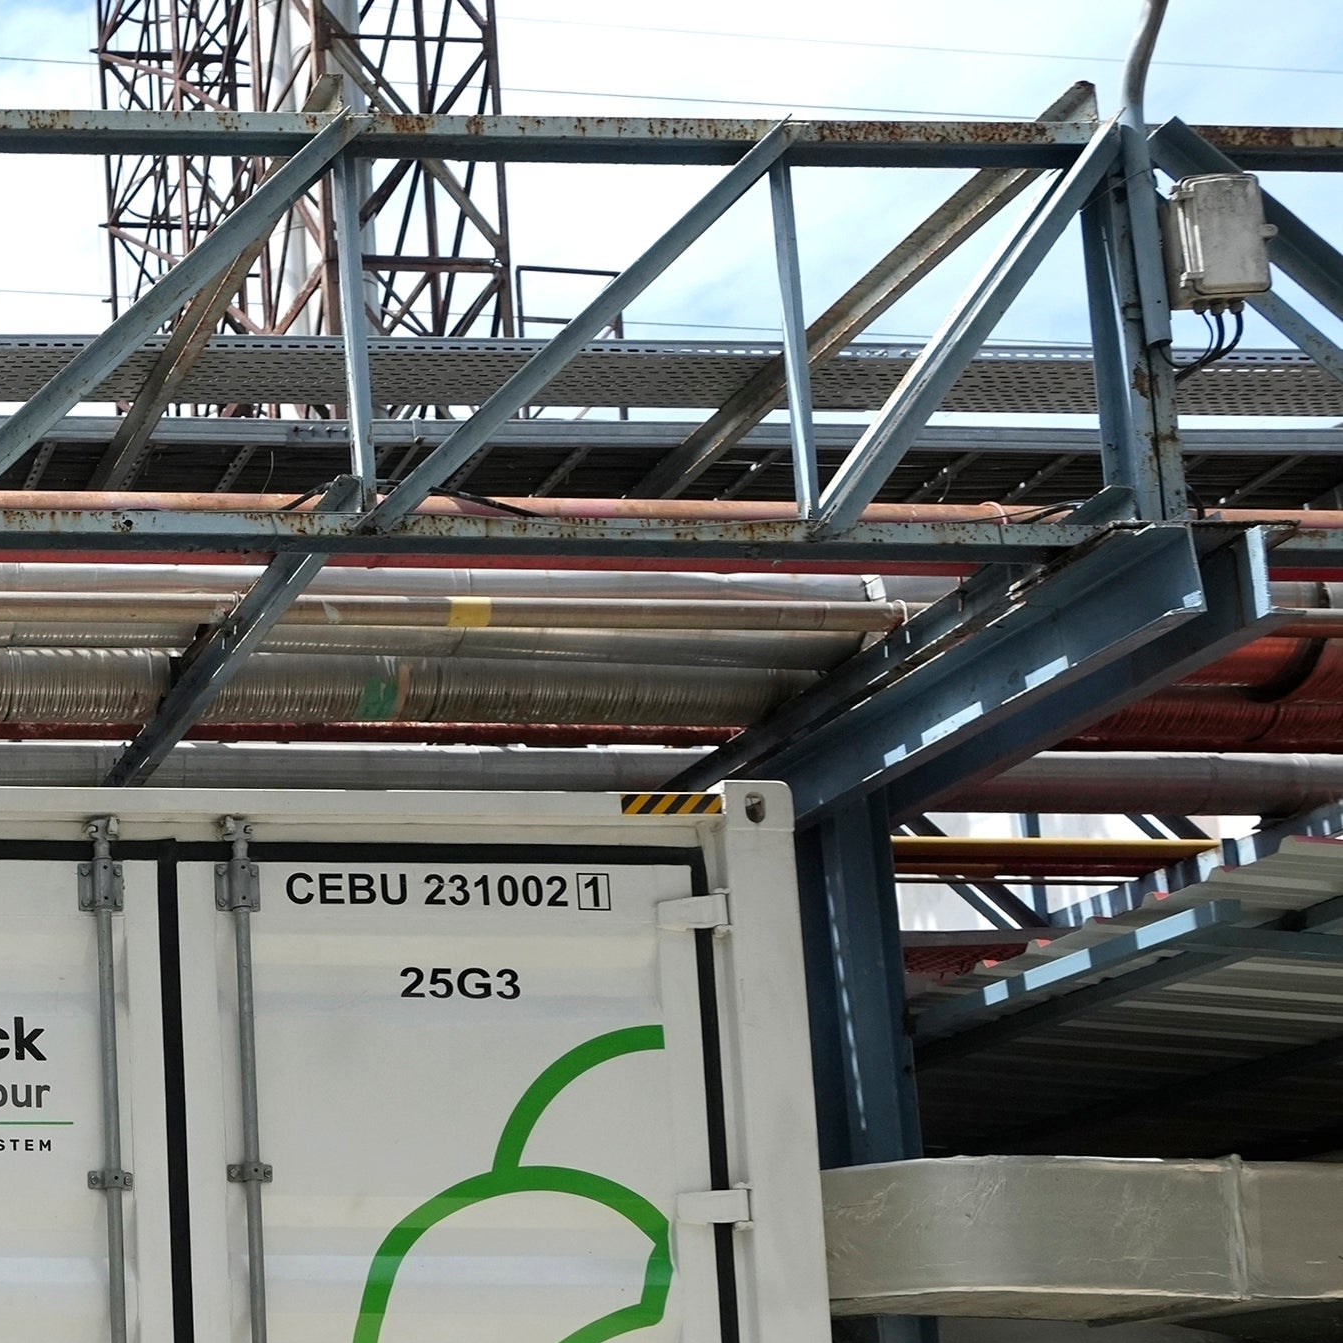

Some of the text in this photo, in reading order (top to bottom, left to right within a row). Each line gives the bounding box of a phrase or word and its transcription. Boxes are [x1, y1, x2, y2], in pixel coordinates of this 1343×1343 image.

[285, 872, 602, 908] CEBU 231002 1
[399, 967, 521, 1000] 25G3
